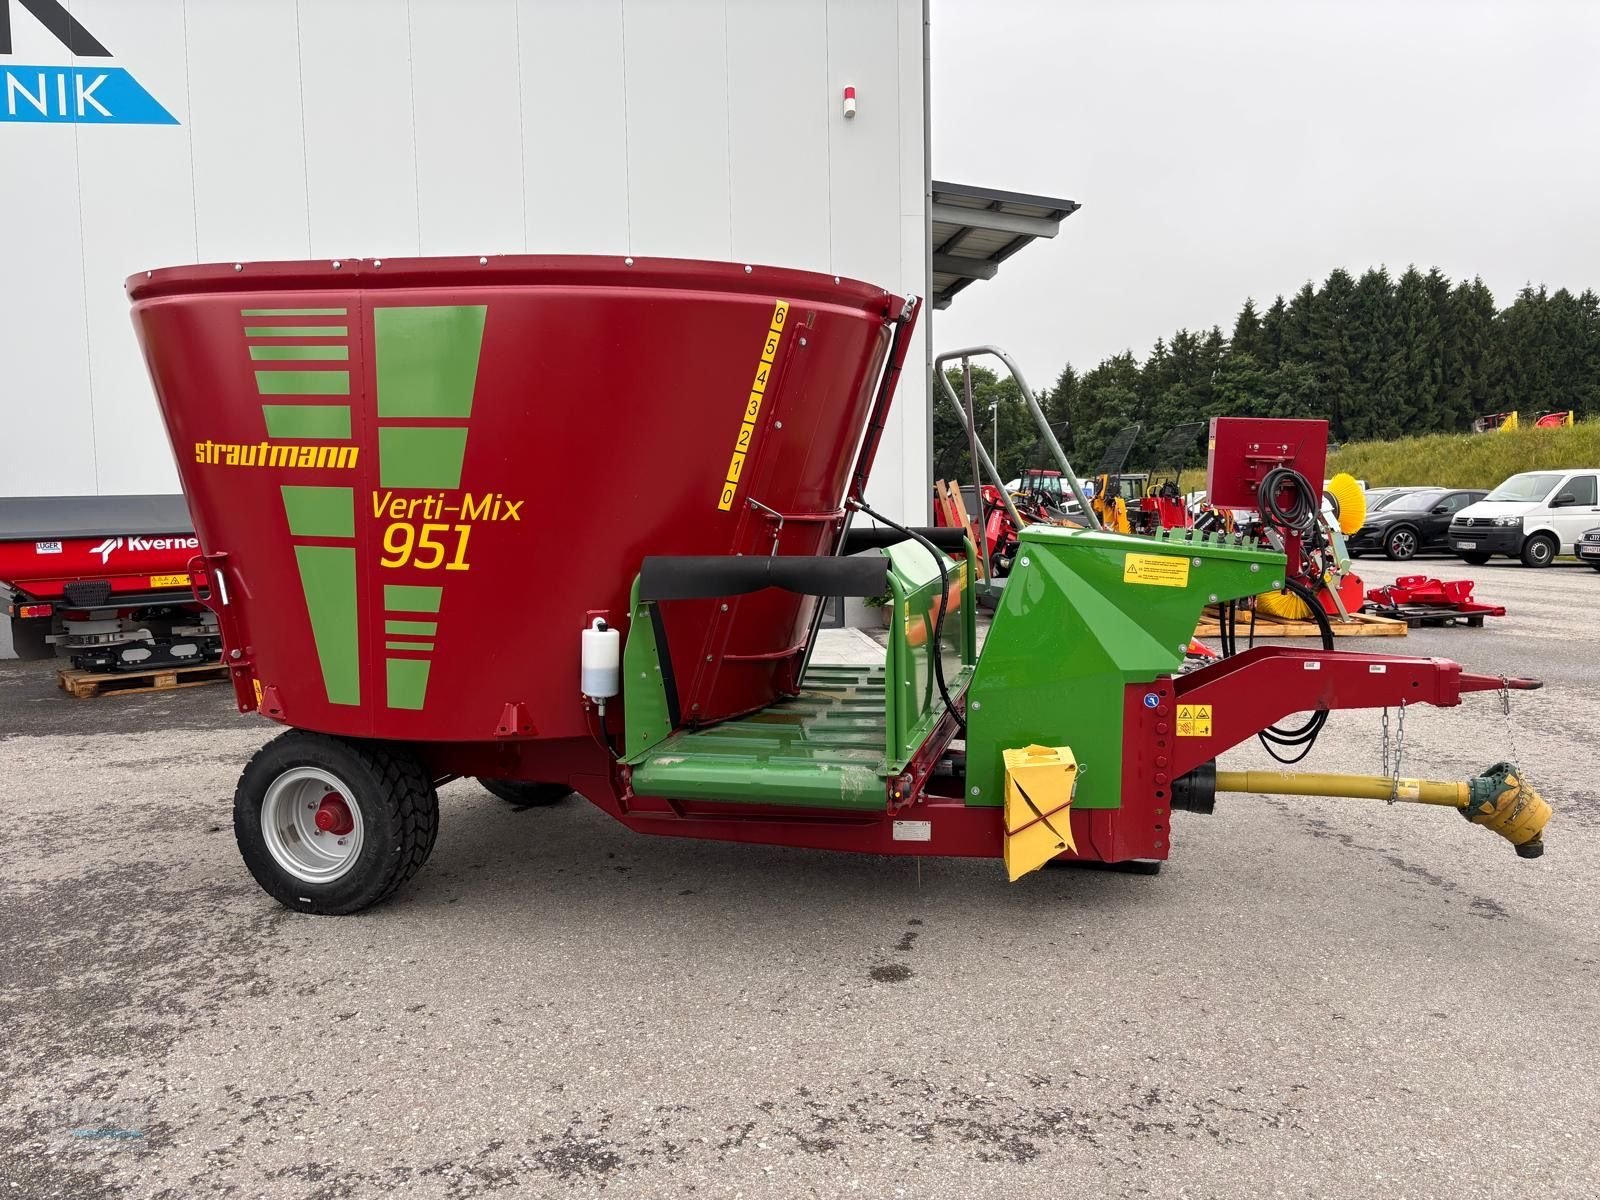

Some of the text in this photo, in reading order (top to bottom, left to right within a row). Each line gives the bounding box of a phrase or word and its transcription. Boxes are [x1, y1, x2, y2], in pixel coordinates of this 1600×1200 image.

[6, 71, 114, 117] NIK
[775, 307, 786, 324] 6
[765, 338, 777, 355] 5
[757, 370, 767, 385] 4
[748, 400, 758, 416] 3
[739, 430, 750, 446] 2
[195, 439, 359, 469] strautmann
[732, 460, 741, 475] 1
[722, 489, 733, 504] 0
[371, 491, 525, 521] Verti-Mix
[127, 536, 199, 552] Kverne
[380, 522, 472, 571] 951
